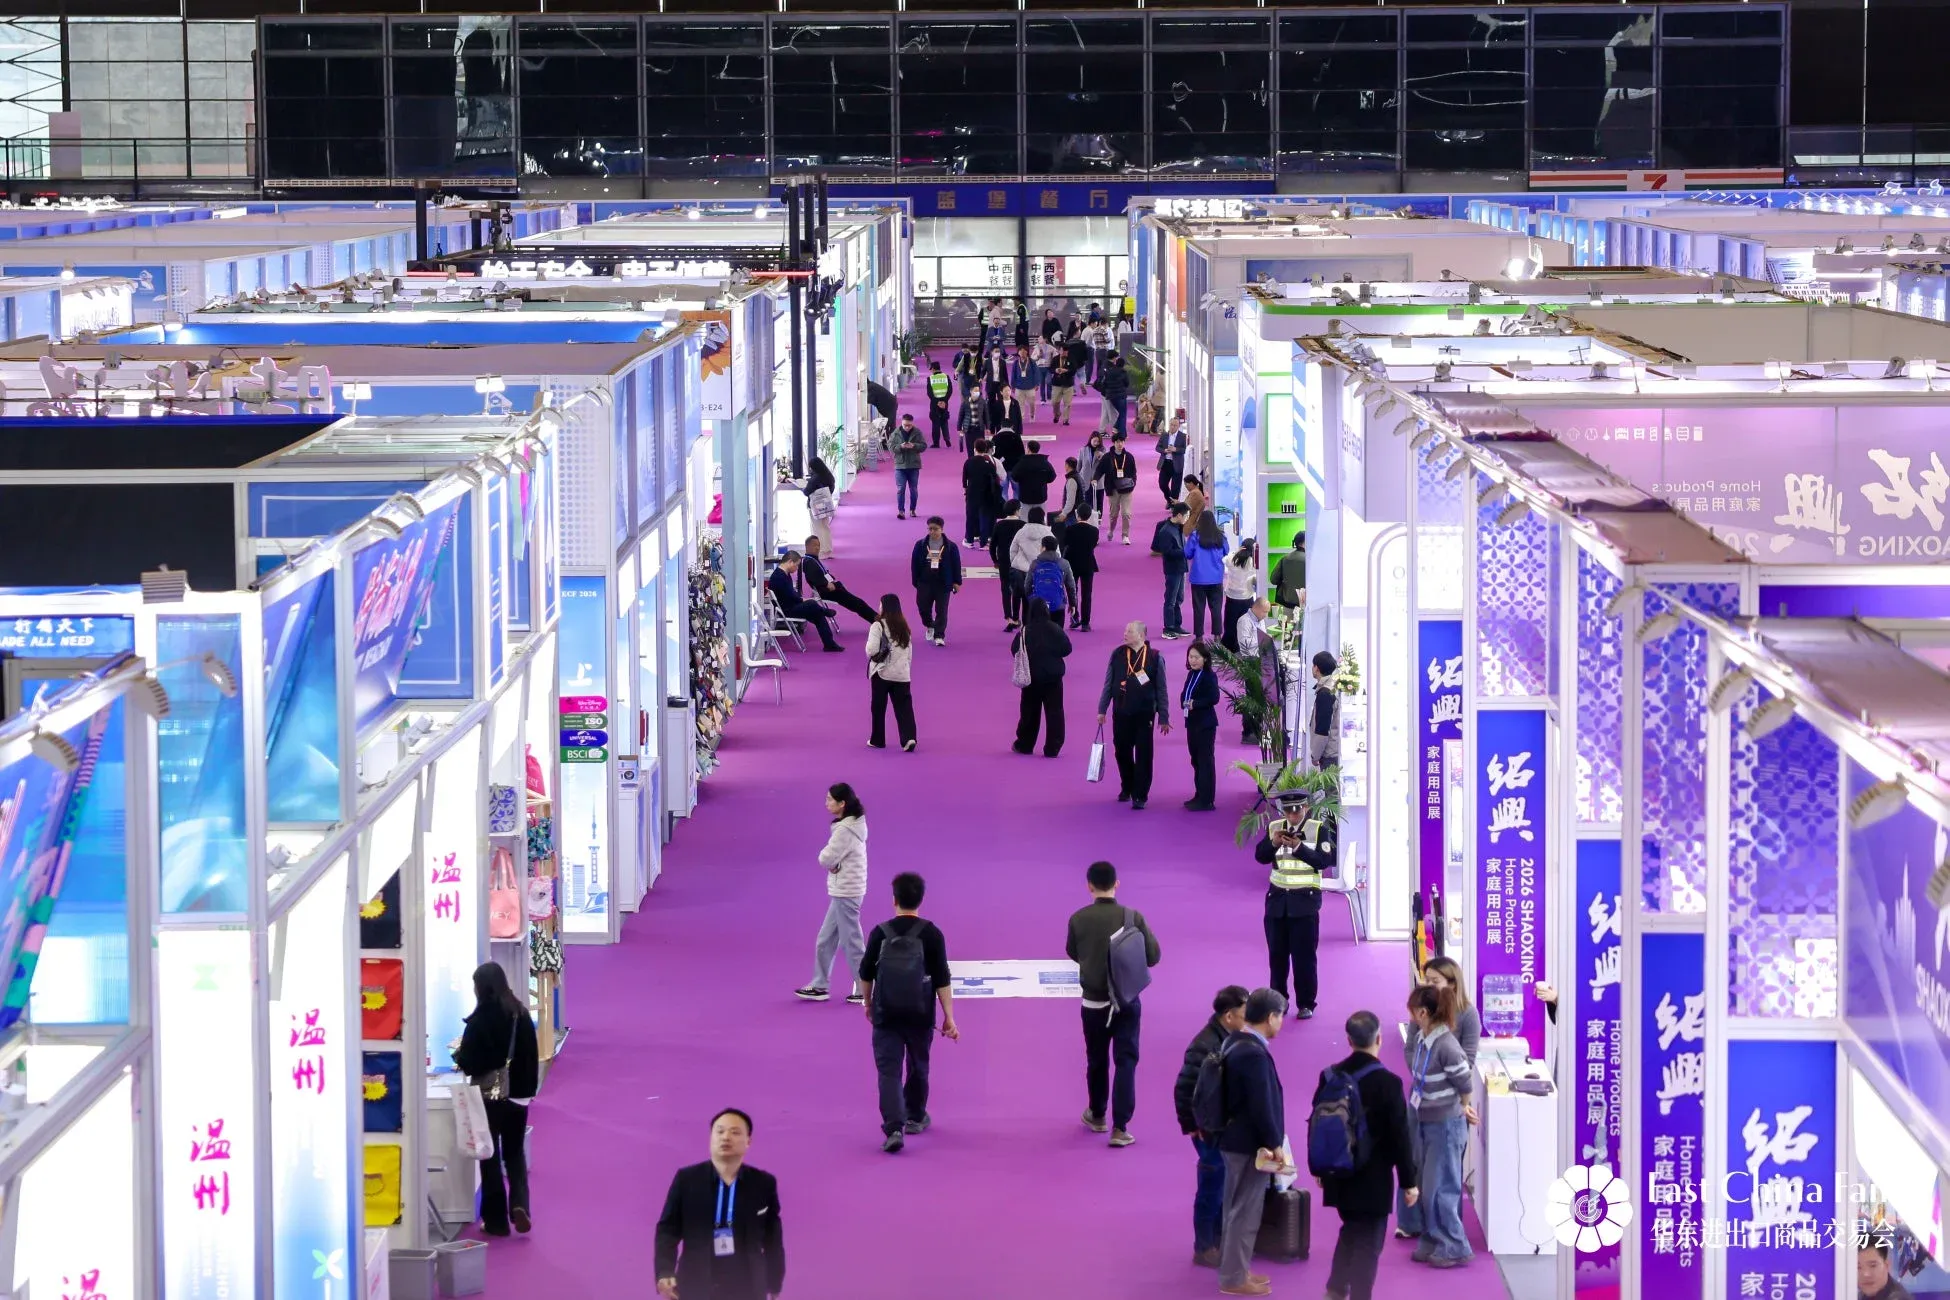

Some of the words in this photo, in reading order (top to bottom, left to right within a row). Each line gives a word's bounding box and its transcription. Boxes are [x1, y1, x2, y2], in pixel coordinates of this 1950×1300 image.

[29, 636, 55, 647] ALL
[60, 635, 94, 646] NEED
[585, 717, 603, 725] ISO
[567, 750, 588, 759] BSCI
[1427, 745, 1441, 820] 家庭用品展
[432, 852, 460, 922] 温州
[1486, 857, 1502, 945] 家庭用品展
[1505, 858, 1516, 896] Home
[1520, 857, 1534, 896] 2026
[1505, 899, 1517, 954] Products
[1520, 900, 1534, 984] SHAOXING
[290, 1007, 325, 1094] 温州
[190, 1118, 230, 1215] 温州
